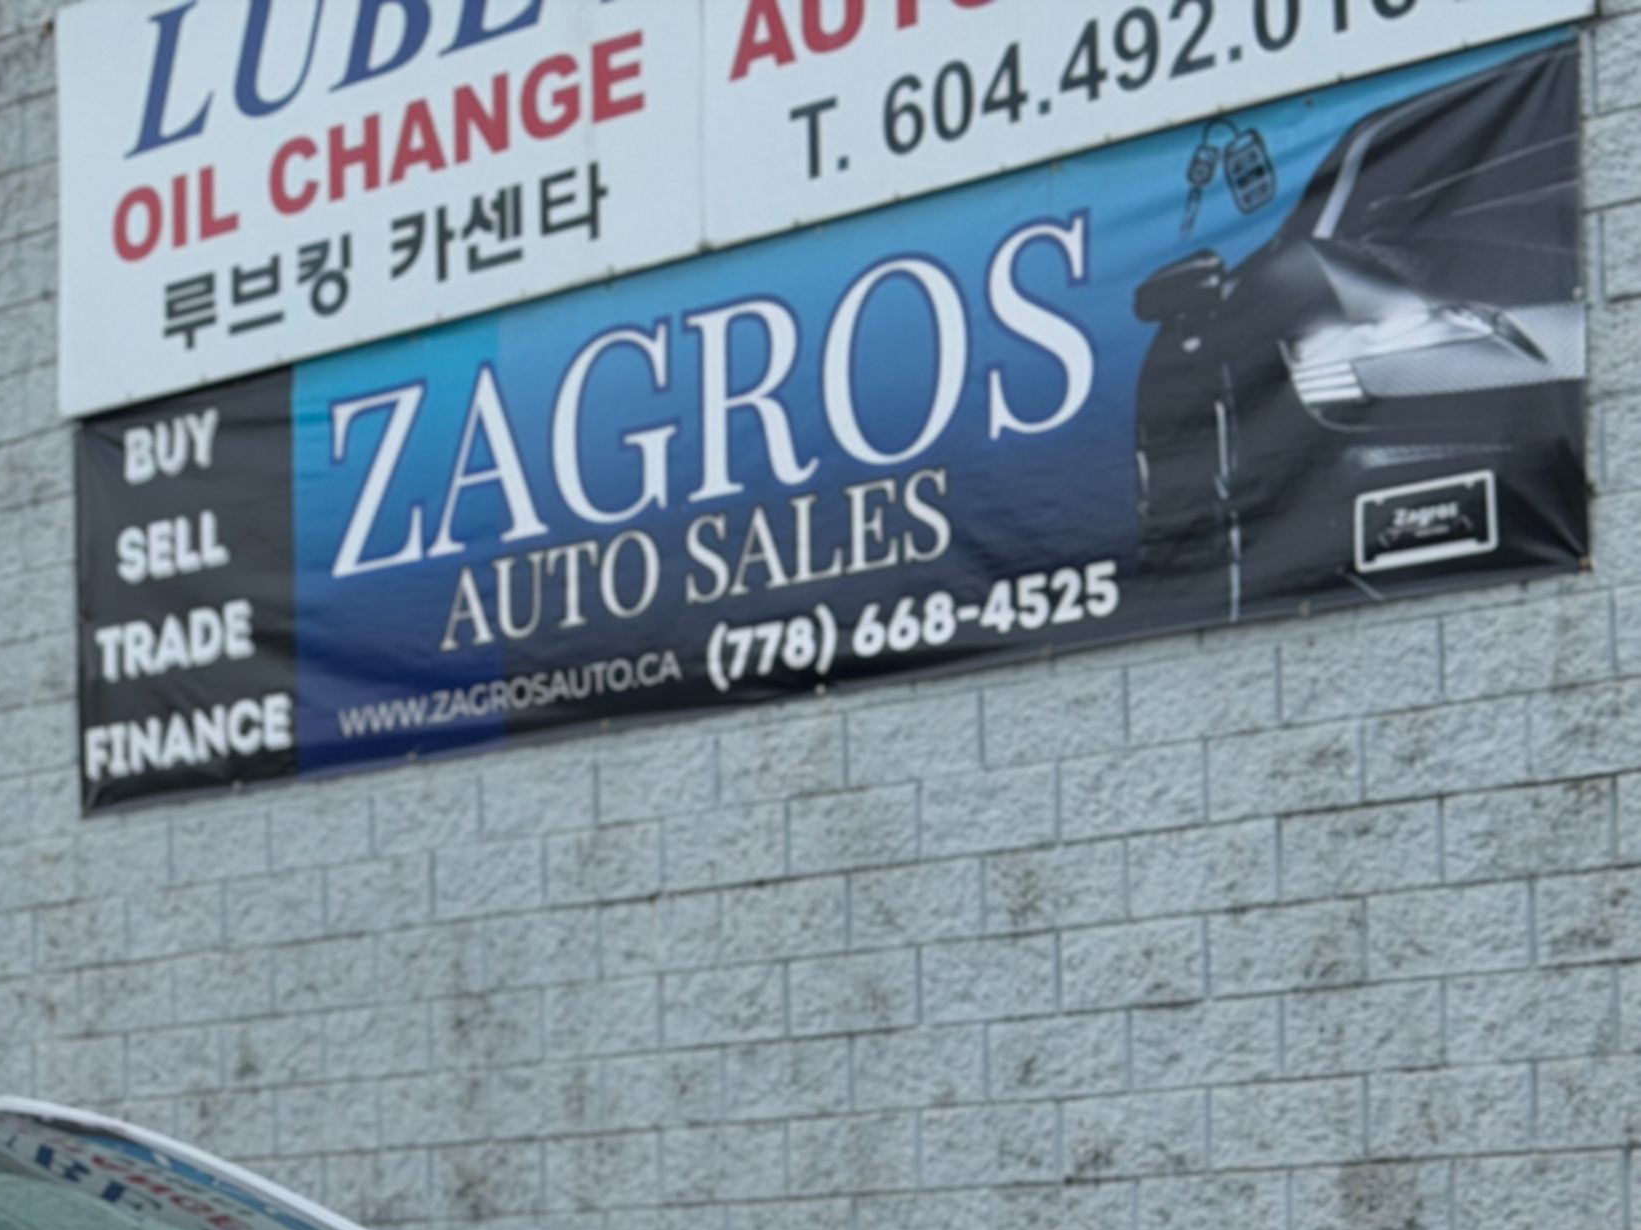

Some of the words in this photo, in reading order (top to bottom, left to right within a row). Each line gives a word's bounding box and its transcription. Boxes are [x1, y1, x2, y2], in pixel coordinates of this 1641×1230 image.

[112, 165, 240, 263] OIL
[268, 29, 646, 216] CHANGE
[788, 96, 850, 181] T.
[162, 232, 353, 351] 루브킹
[388, 161, 608, 283] 카센타
[330, 215, 1095, 578] ZAGROS
[123, 409, 219, 484] BUY
[116, 510, 229, 584] SELL
[440, 529, 660, 652] AUTO
[685, 468, 952, 604] SALES
[95, 599, 256, 683] TRADE
[706, 604, 837, 692] (778)
[851, 560, 1120, 657] 668-4525
[84, 694, 293, 781] FINANCE
[338, 650, 683, 738] WWW.ZAGROSAUTO.CA
